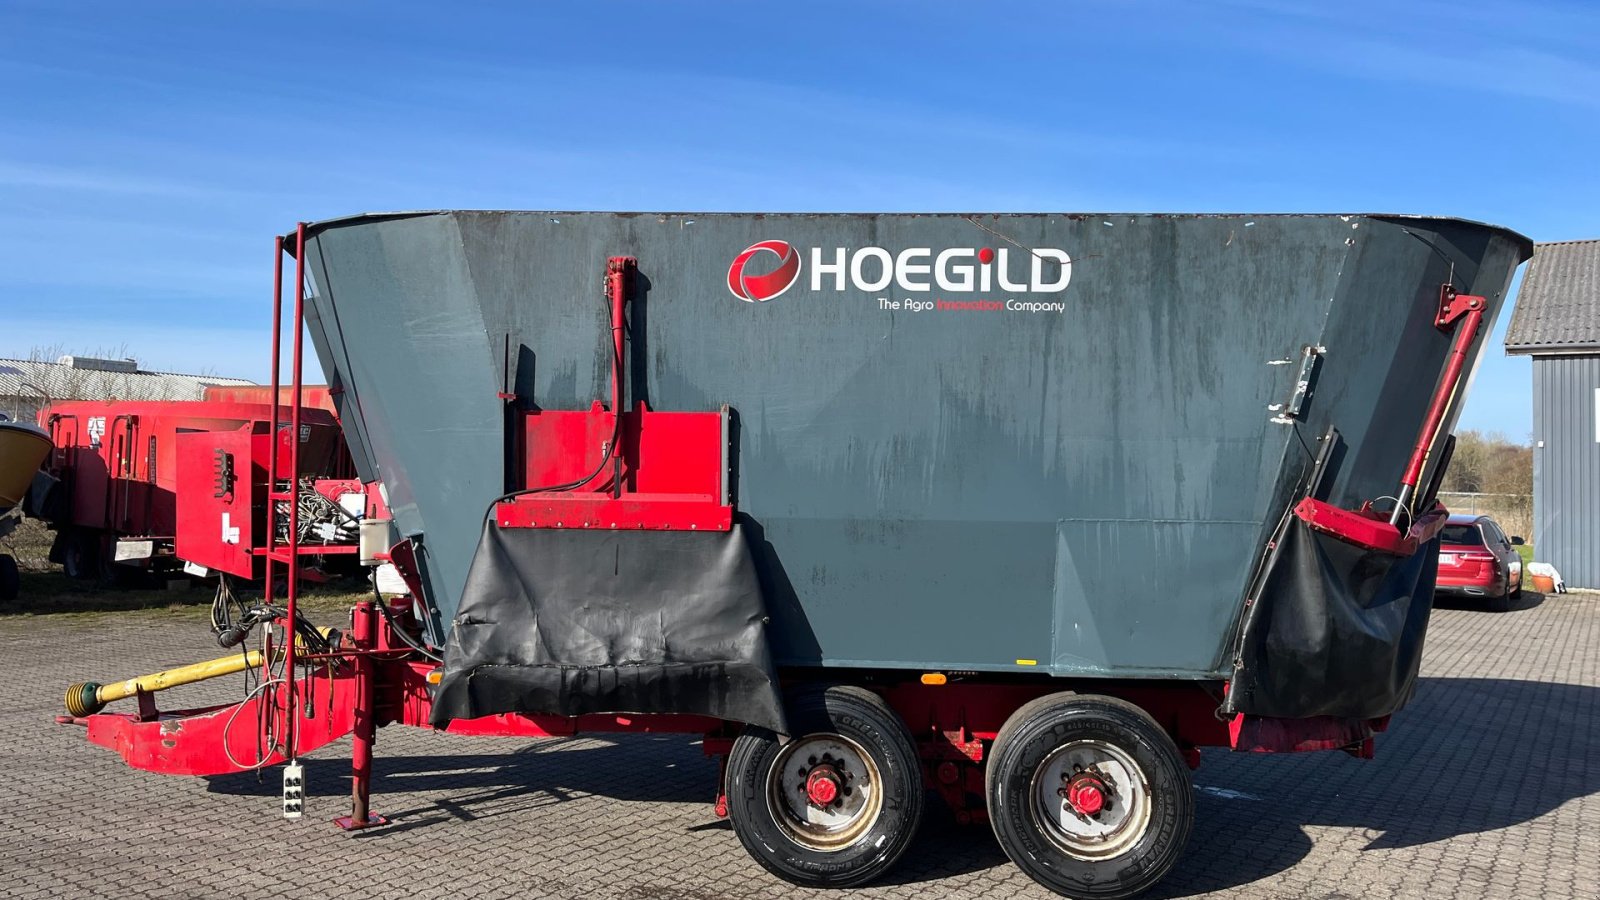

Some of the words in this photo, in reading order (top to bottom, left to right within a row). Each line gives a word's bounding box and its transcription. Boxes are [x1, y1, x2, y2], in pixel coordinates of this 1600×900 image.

[877, 298, 902, 310] The
[904, 298, 934, 312] Agro
[937, 299, 1004, 311] Innovation
[1006, 299, 1065, 314] Company
